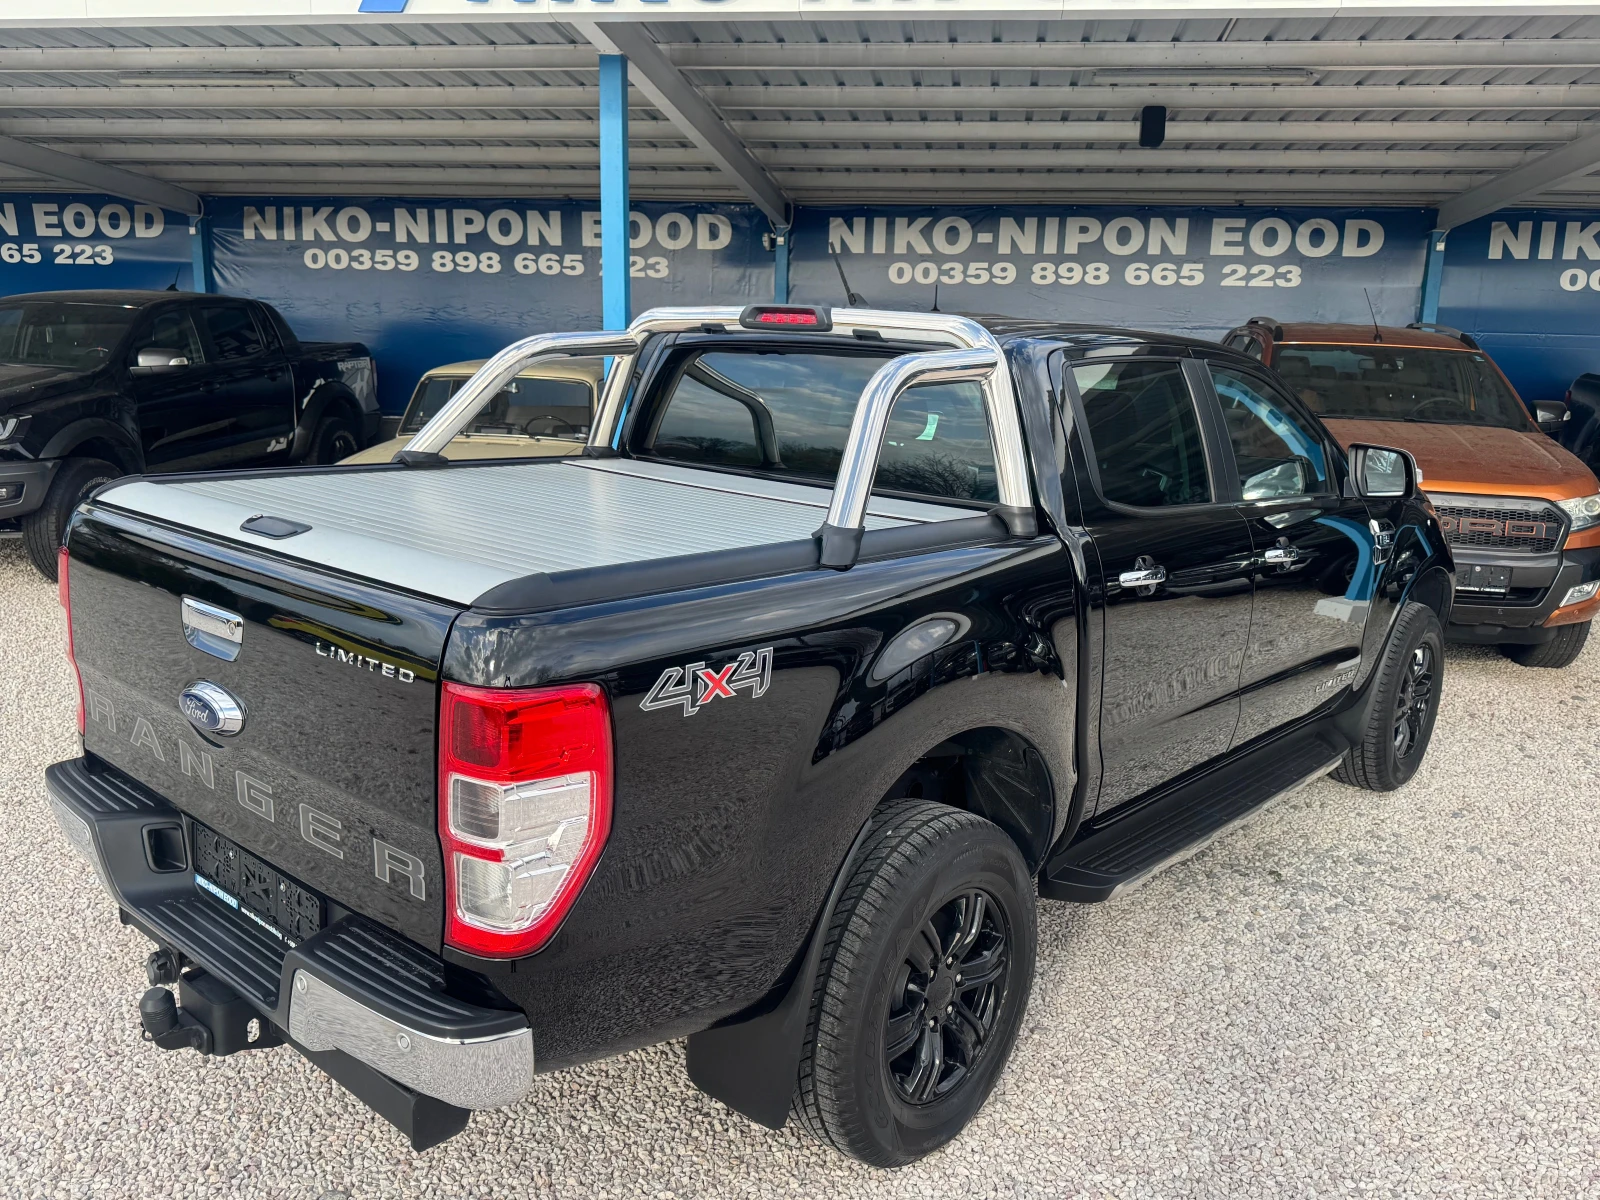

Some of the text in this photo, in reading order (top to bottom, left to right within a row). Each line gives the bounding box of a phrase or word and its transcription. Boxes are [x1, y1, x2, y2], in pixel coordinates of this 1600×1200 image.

[32, 203, 165, 238] EOOD
[243, 206, 732, 250] NIKO-NIPON EOOD
[828, 216, 1385, 257] NIKO-NIPON EOOD
[53, 244, 114, 265] 223
[303, 248, 669, 278] 00359 898 665 23
[888, 262, 1302, 287] 00359 898 665 223
[315, 642, 415, 684] LIMITED
[1315, 669, 1356, 693] LIMITED
[185, 696, 209, 723] Ford
[88, 688, 426, 901] RANGER
